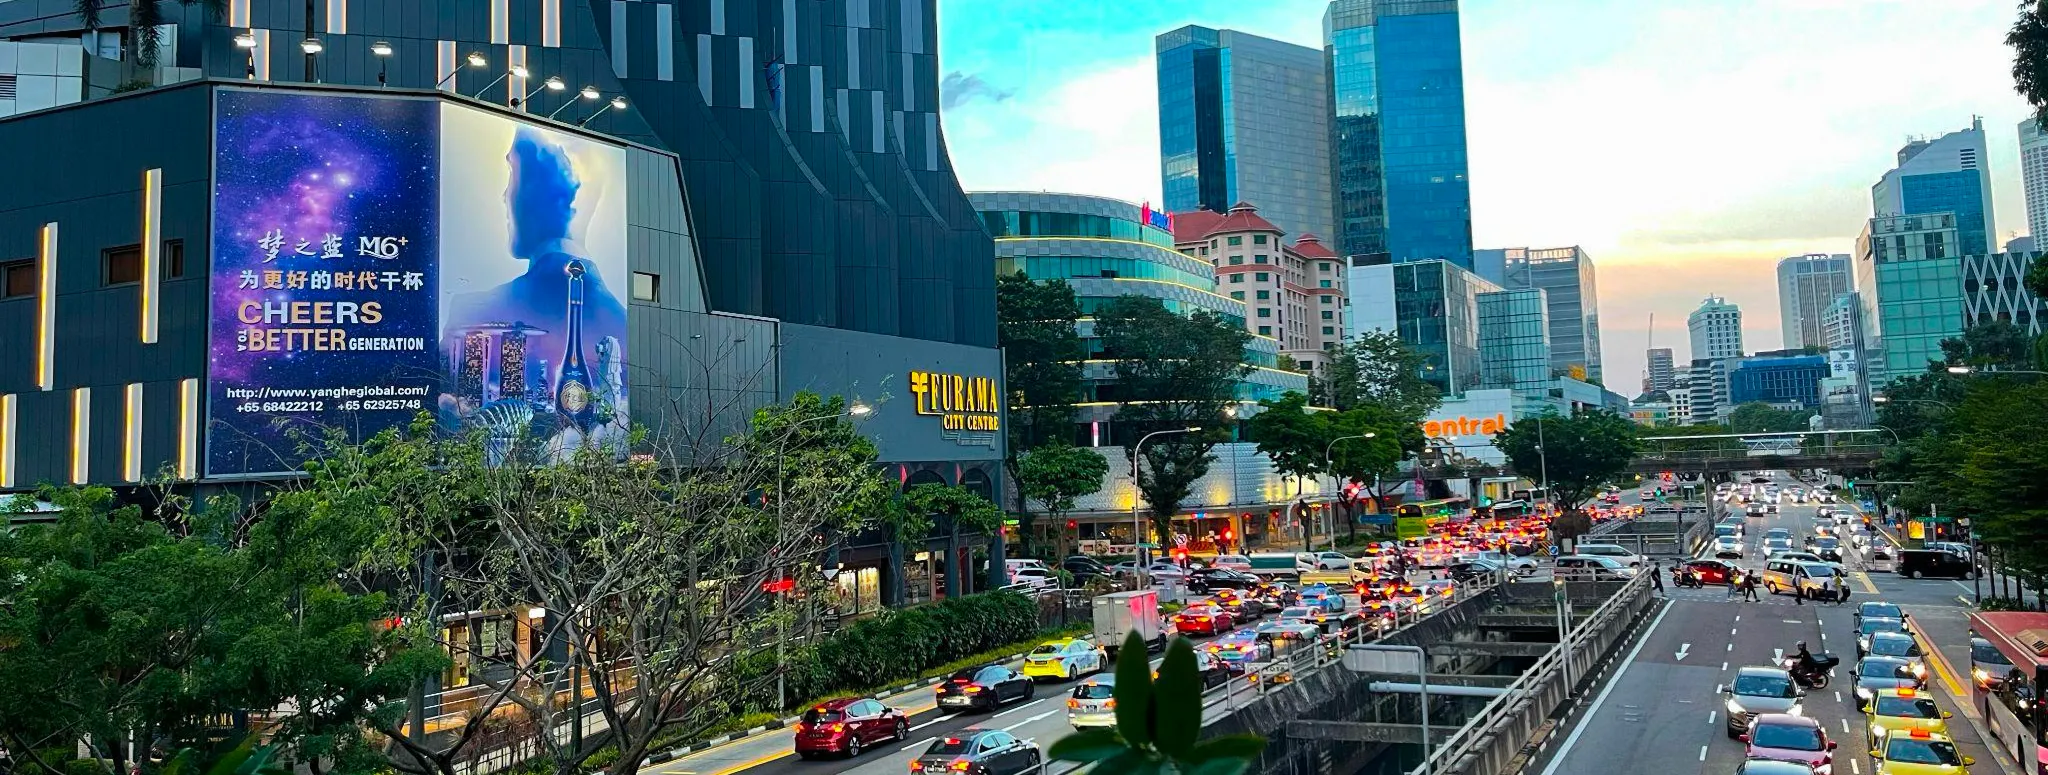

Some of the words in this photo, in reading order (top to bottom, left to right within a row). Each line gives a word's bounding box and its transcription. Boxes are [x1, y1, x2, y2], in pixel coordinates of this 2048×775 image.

[258, 229, 343, 263] 梦之蓝
[355, 236, 409, 260] M6+
[239, 270, 424, 291] 为更好的时代干杯
[237, 301, 383, 324] CHEERS
[249, 328, 347, 351] BETTER
[349, 338, 424, 351] GENERATION
[226, 385, 430, 399] http://www.yangheglobal.com/
[930, 373, 998, 412] FURAMA
[236, 403, 259, 413] +65
[263, 402, 323, 412] 68422212
[337, 401, 360, 411] +65
[363, 400, 421, 410] 62925748
[943, 414, 964, 430] CITY
[967, 415, 999, 430] CENTRE
[1416, 412, 1505, 437] entral
